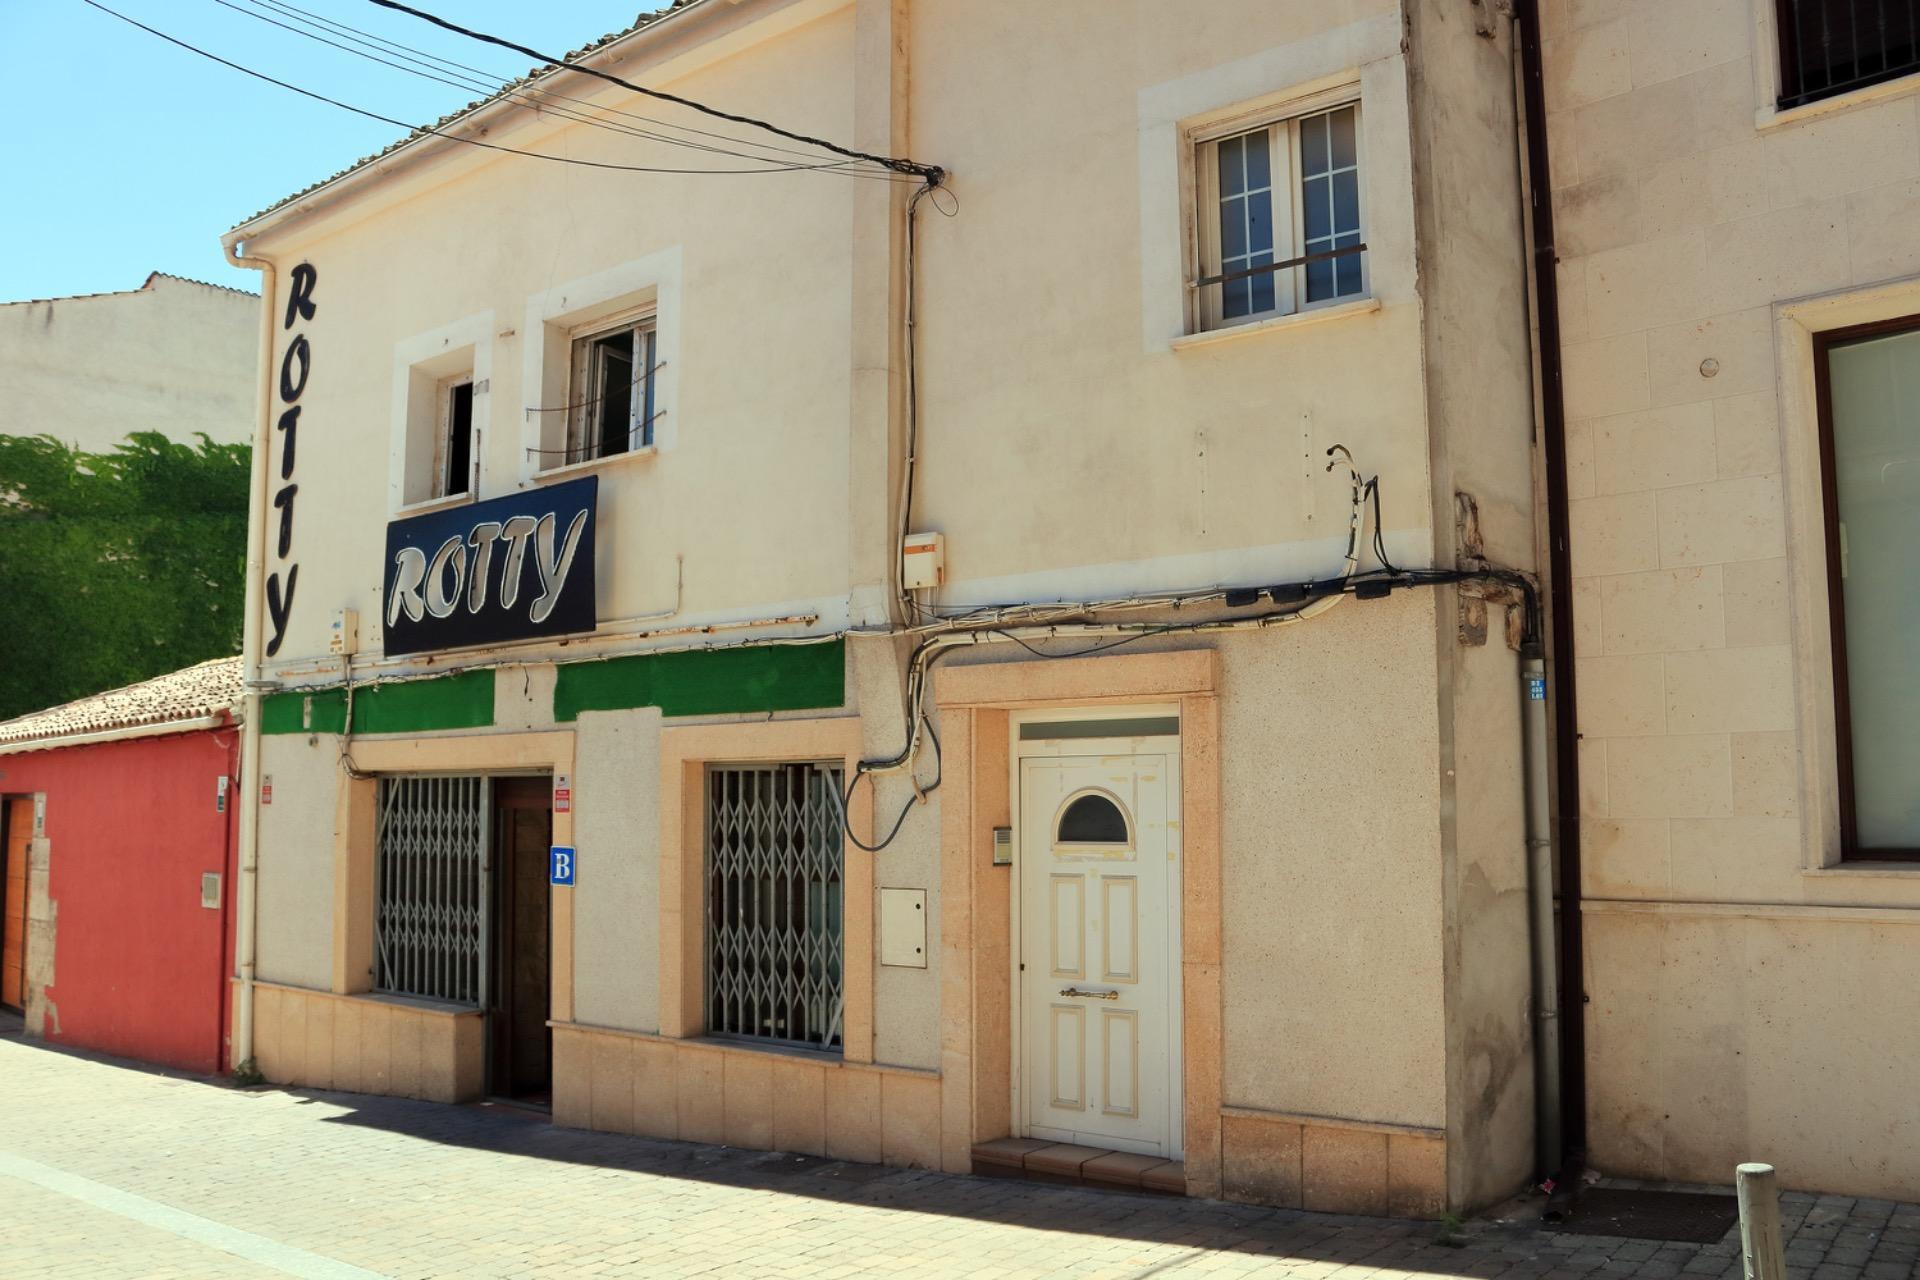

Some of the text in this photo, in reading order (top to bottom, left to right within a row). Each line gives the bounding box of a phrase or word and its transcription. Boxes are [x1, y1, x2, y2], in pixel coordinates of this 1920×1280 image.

[266, 263, 317, 657] ROTTY
[387, 509, 588, 627] ROTTY
[554, 853, 570, 879] B
